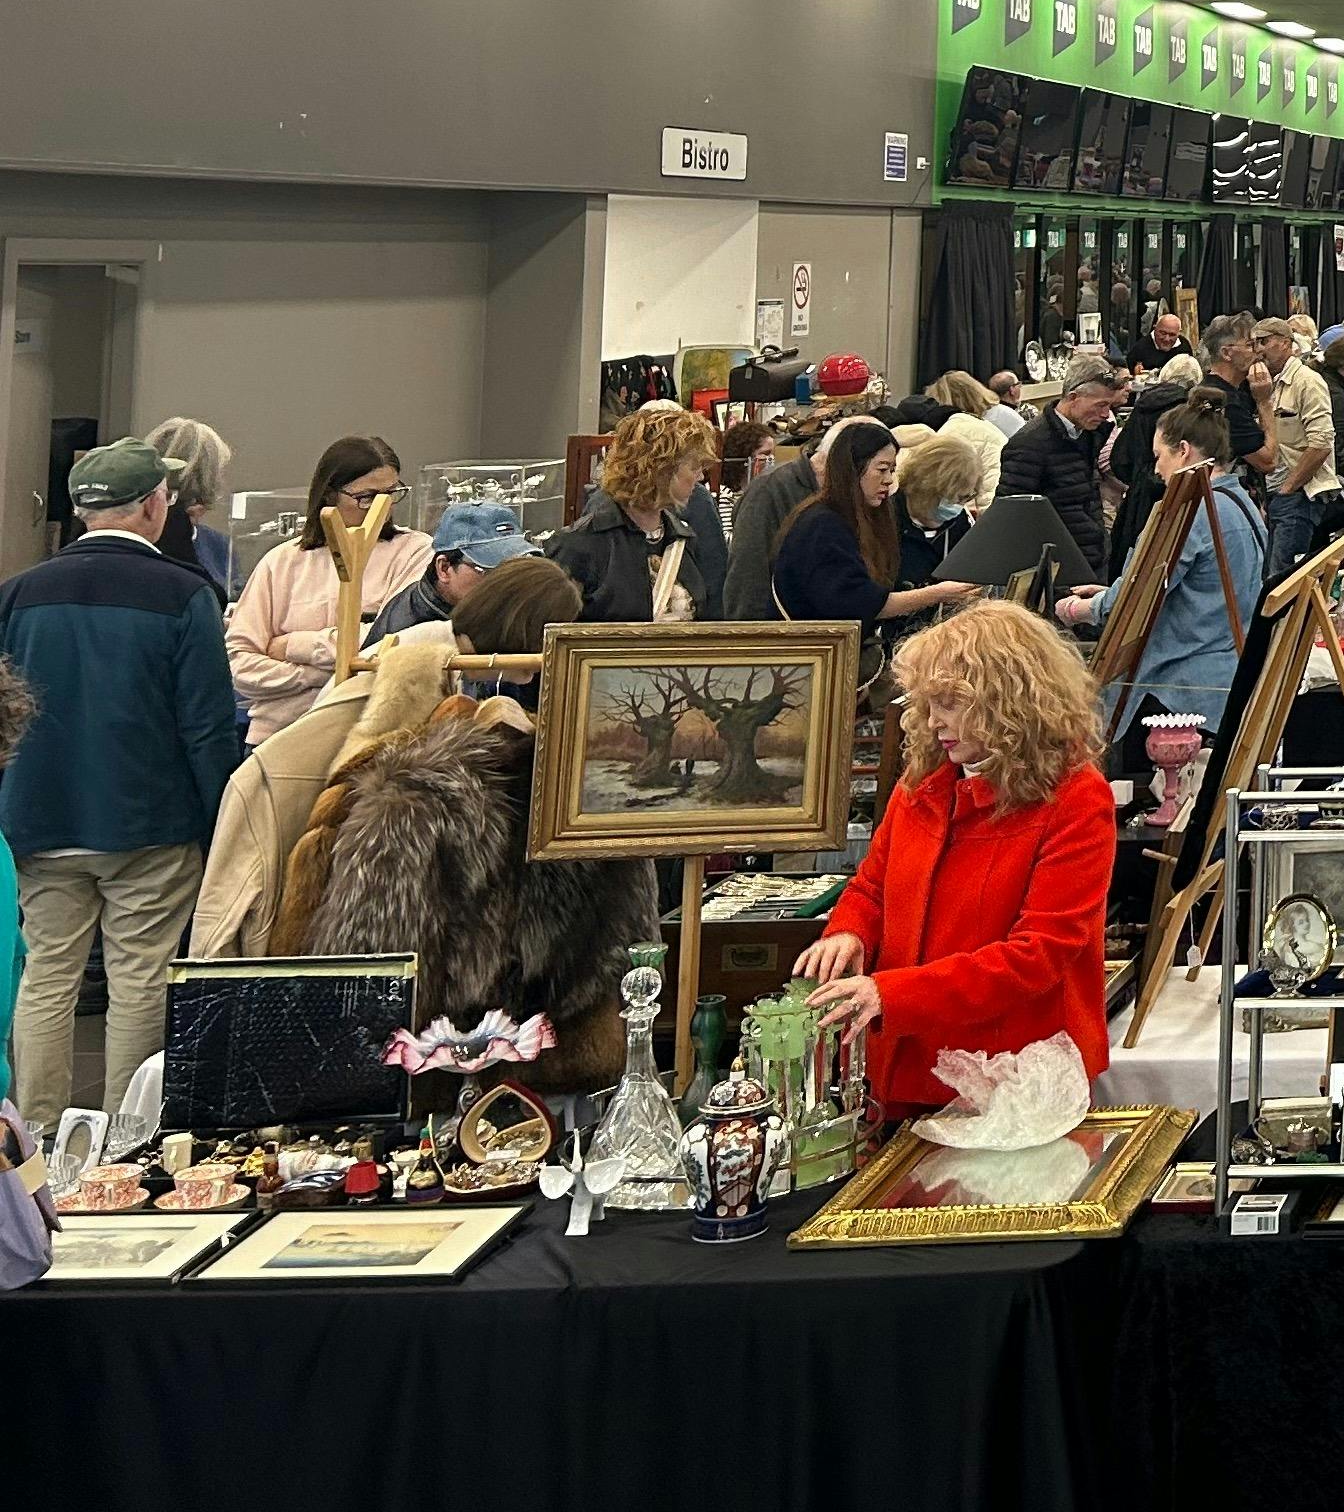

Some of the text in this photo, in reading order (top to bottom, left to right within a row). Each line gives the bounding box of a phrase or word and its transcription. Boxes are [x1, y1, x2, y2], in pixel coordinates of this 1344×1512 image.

[1055, 1, 1076, 35] TAB
[1098, 14, 1116, 46] TAB
[1135, 25, 1152, 56] TAB
[1170, 36, 1186, 64] TAB
[1202, 44, 1217, 72] TAB
[1232, 53, 1245, 79] TAB
[1258, 60, 1271, 86] TAB
[1284, 68, 1295, 93] TAB
[681, 138, 729, 172] Bistro
